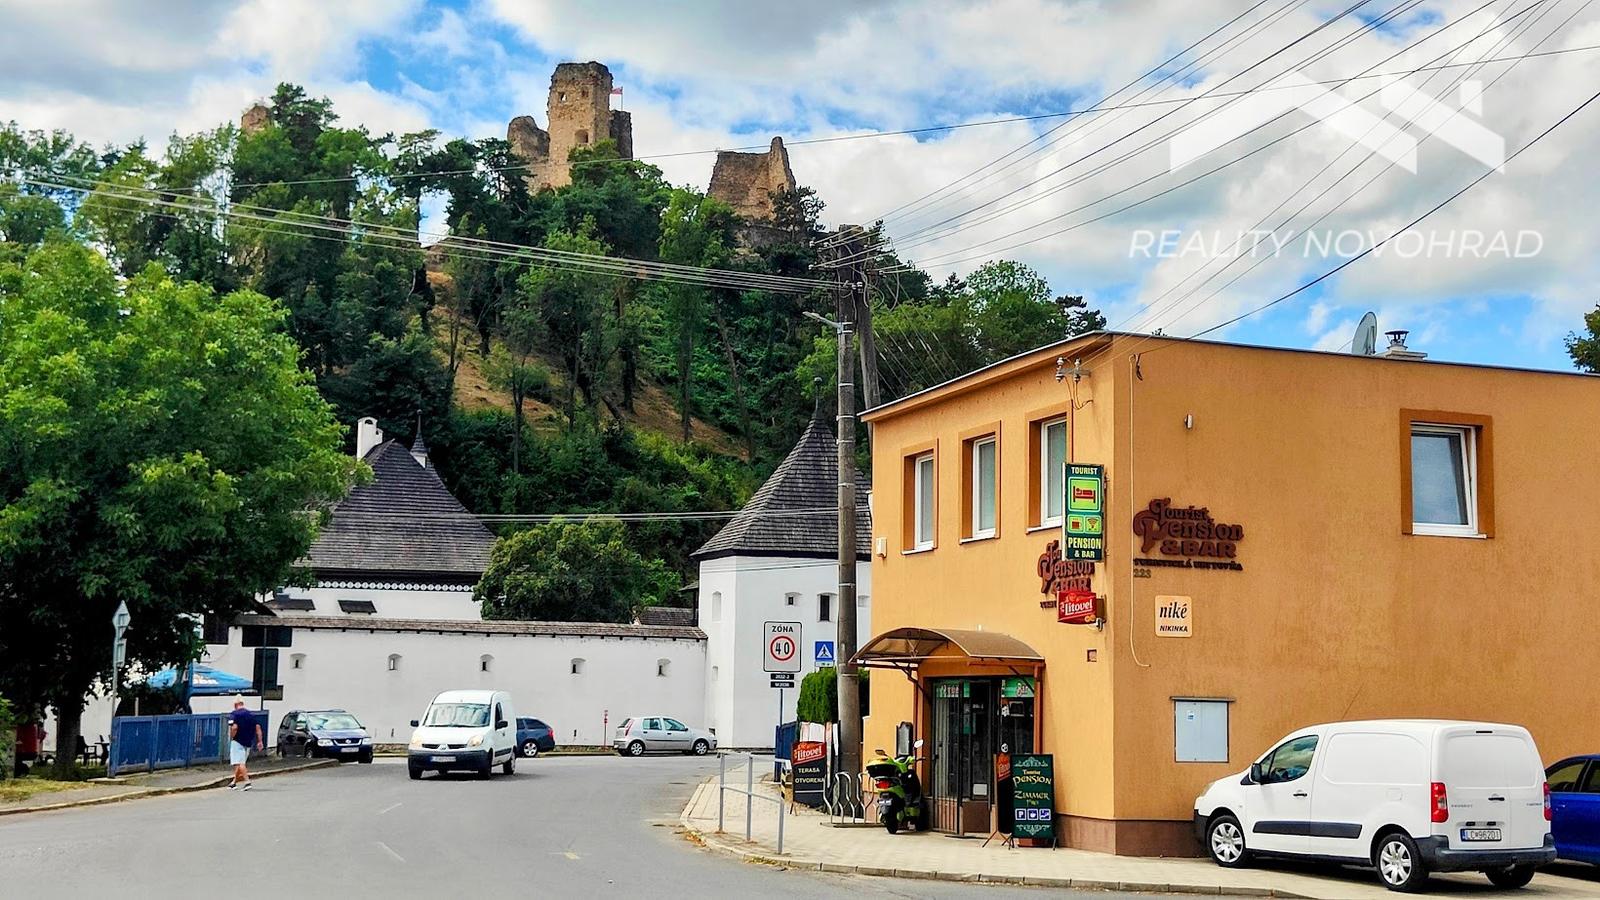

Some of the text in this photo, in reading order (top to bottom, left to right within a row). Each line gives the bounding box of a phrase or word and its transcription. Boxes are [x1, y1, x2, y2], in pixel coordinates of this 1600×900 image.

[1071, 467, 1098, 475] TOURIST
[1068, 537, 1101, 549] PENSION
[1074, 550, 1095, 558] & BAR
[1065, 600, 1093, 615] Litovel
[1160, 602, 1187, 618] niké
[775, 642, 790, 655] 40
[797, 746, 821, 760] Litovel
